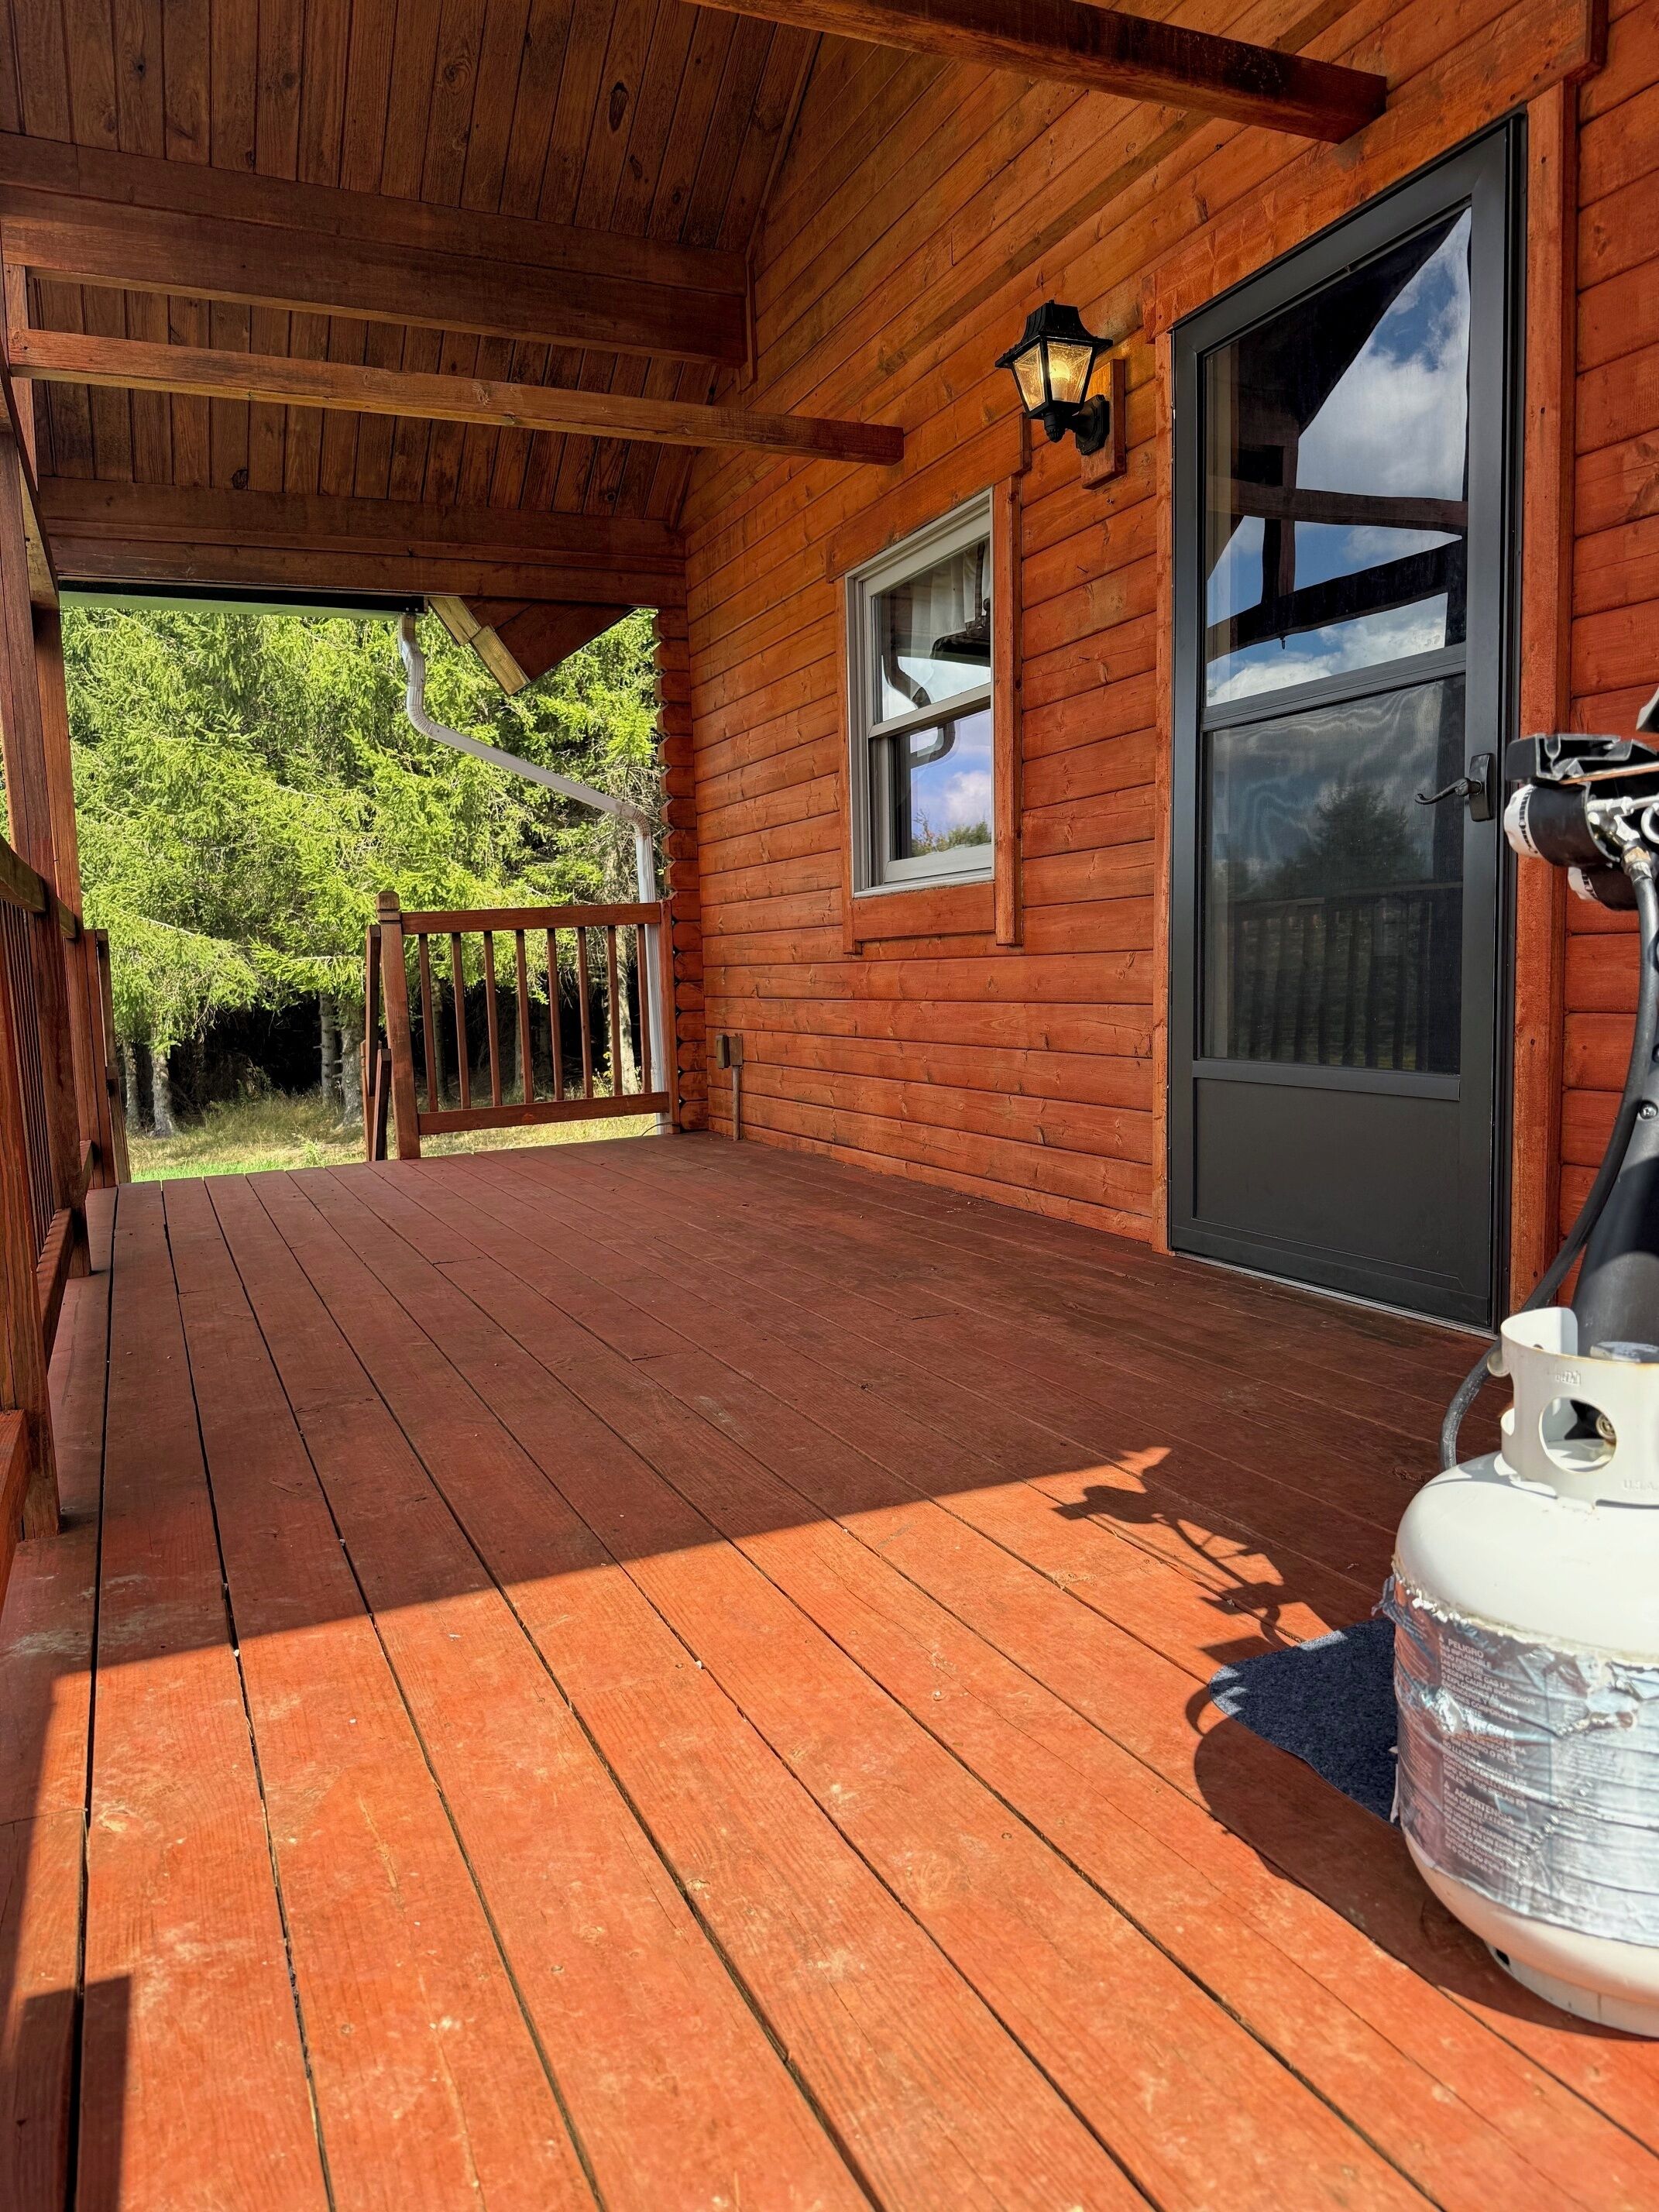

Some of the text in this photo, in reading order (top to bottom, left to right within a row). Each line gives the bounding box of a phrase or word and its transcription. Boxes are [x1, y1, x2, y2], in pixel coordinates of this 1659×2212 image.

[1448, 1638, 1484, 1659] PELIGRO
[1451, 1647, 1492, 1669] INFLAMABLE
[1465, 1676, 1492, 1692] CAUSAR
[1493, 1687, 1536, 1705] INCENDIOS
[1455, 1788, 1514, 1824] ADVERTENCIA
